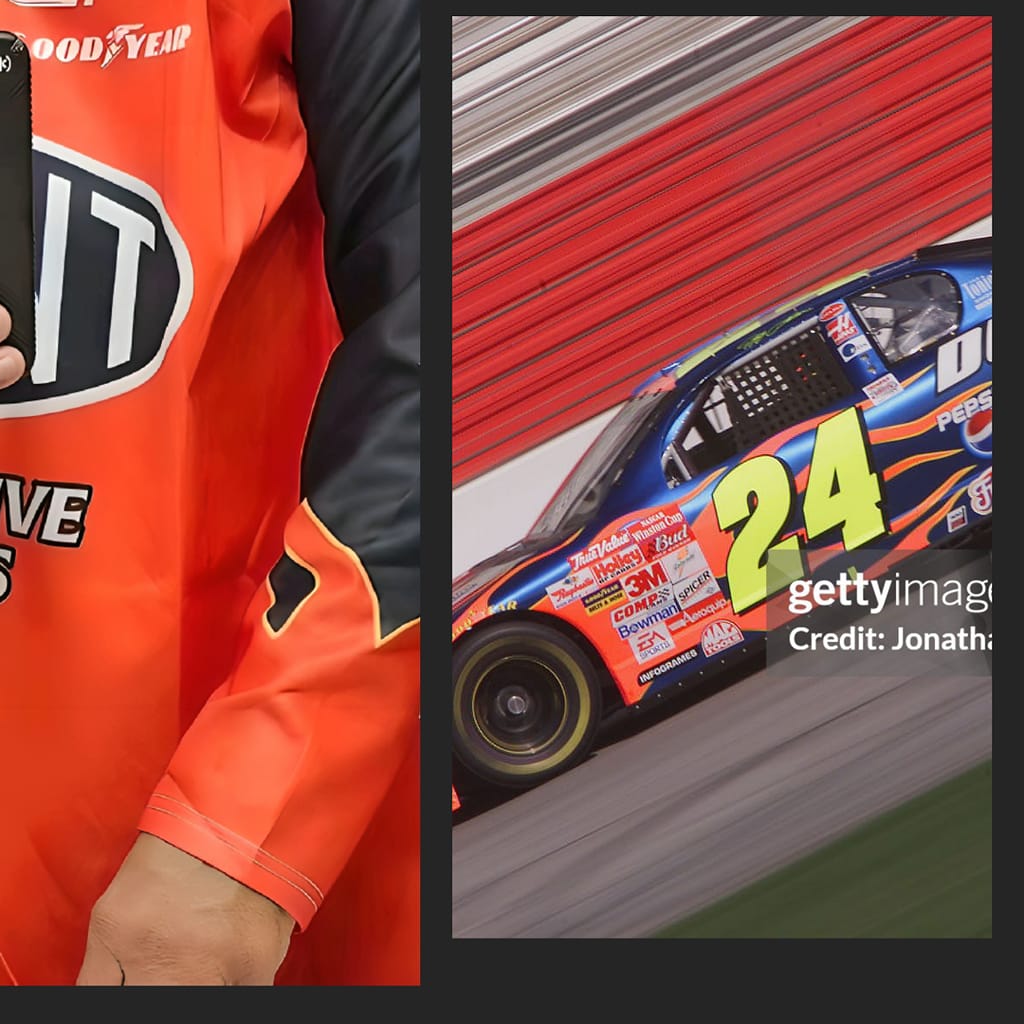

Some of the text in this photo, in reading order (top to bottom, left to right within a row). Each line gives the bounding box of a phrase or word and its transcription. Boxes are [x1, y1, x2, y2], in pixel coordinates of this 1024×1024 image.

[16, 24, 192, 64] OODYEAR
[712, 406, 888, 616] 24
[625, 561, 669, 598] 3M
[678, 570, 711, 602] SPICER
[614, 591, 658, 623] COMP
[618, 604, 679, 639] Bowman
[640, 648, 698, 683] INFOGRAMES
